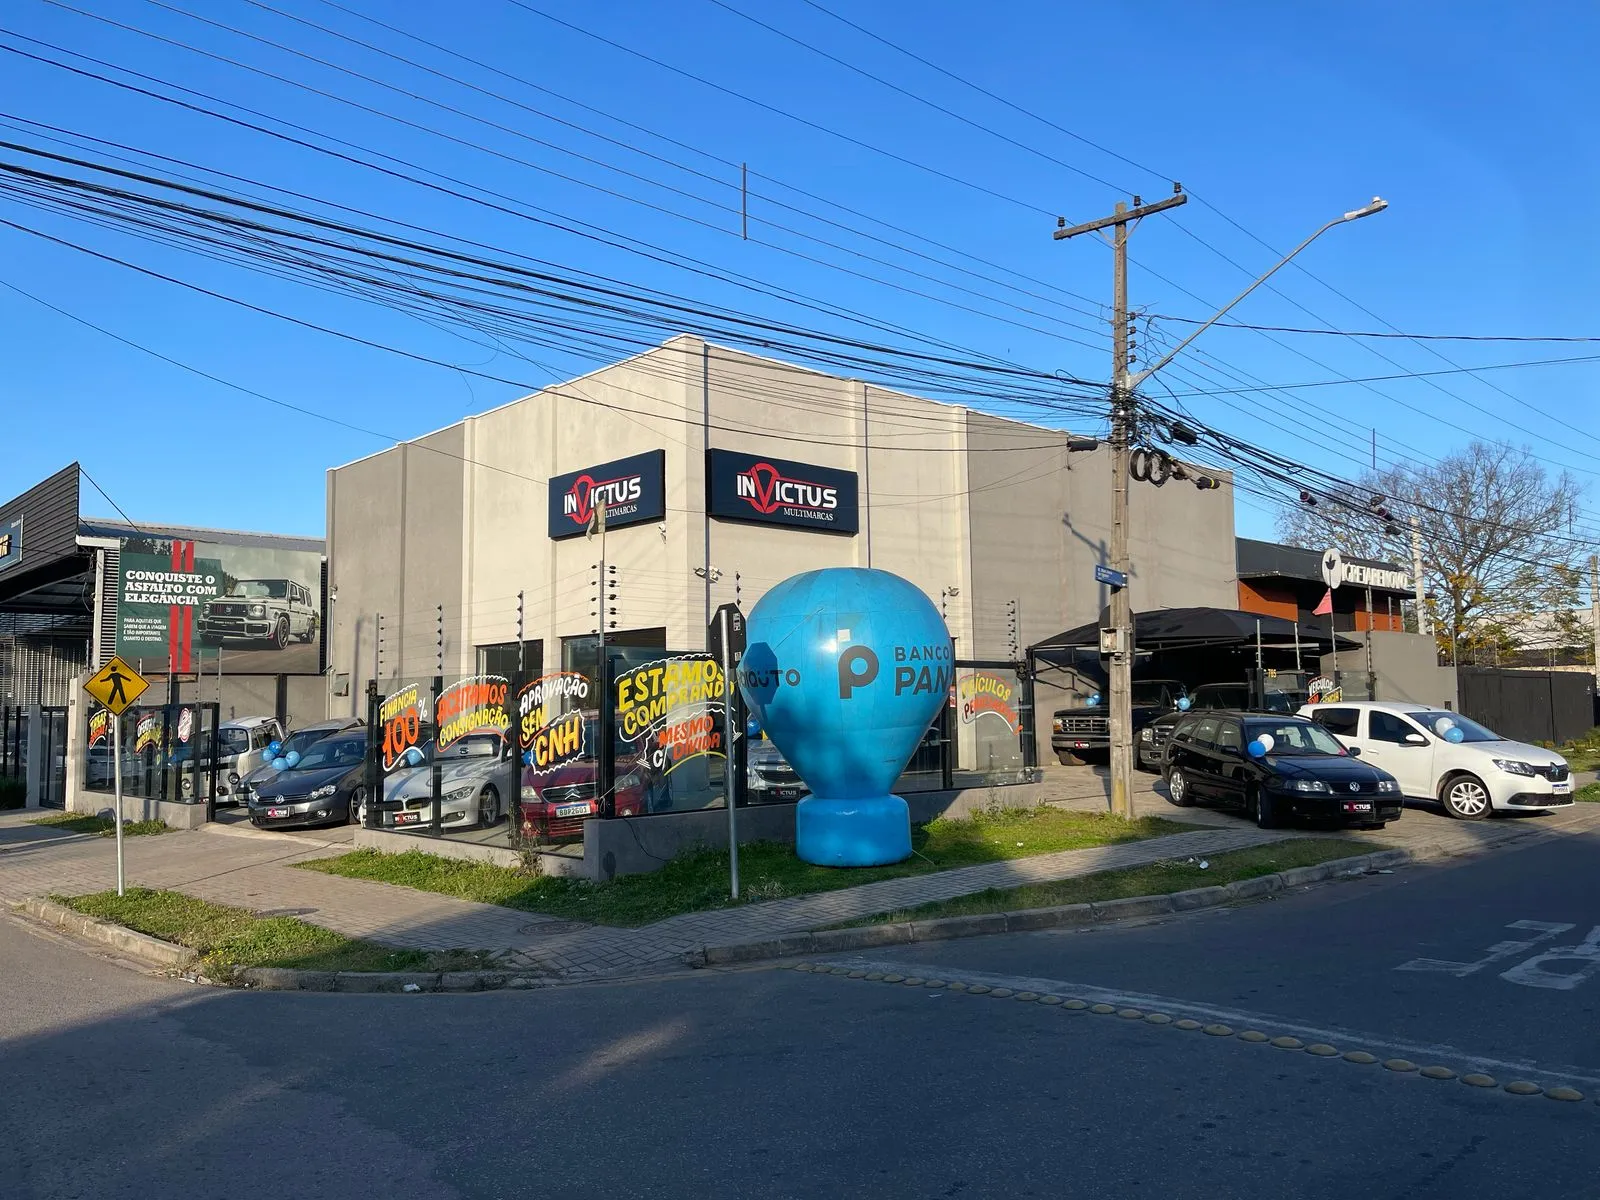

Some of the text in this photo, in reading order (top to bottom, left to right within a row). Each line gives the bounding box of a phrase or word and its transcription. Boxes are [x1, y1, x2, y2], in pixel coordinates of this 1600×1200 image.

[563, 476, 641, 522] INVICTUS
[736, 463, 838, 513] INVICTUS
[605, 504, 638, 518] LTIMARCAS
[783, 507, 834, 521] MULTIMARCAS
[124, 582, 217, 595] ASFALTO COM
[125, 570, 215, 584] CONQUISTE O
[124, 592, 199, 605] ELEGÂNCIA
[894, 646, 950, 662] BANCO
[519, 674, 588, 717] APROVAÇÃO
[895, 665, 950, 696] PAN
[380, 689, 417, 728] FINANCIA
[436, 684, 507, 728] ACEITAMOS
[439, 706, 509, 747] CONSIGNAÇÃO
[535, 716, 580, 767] CNH
[659, 715, 714, 748] MESMO
